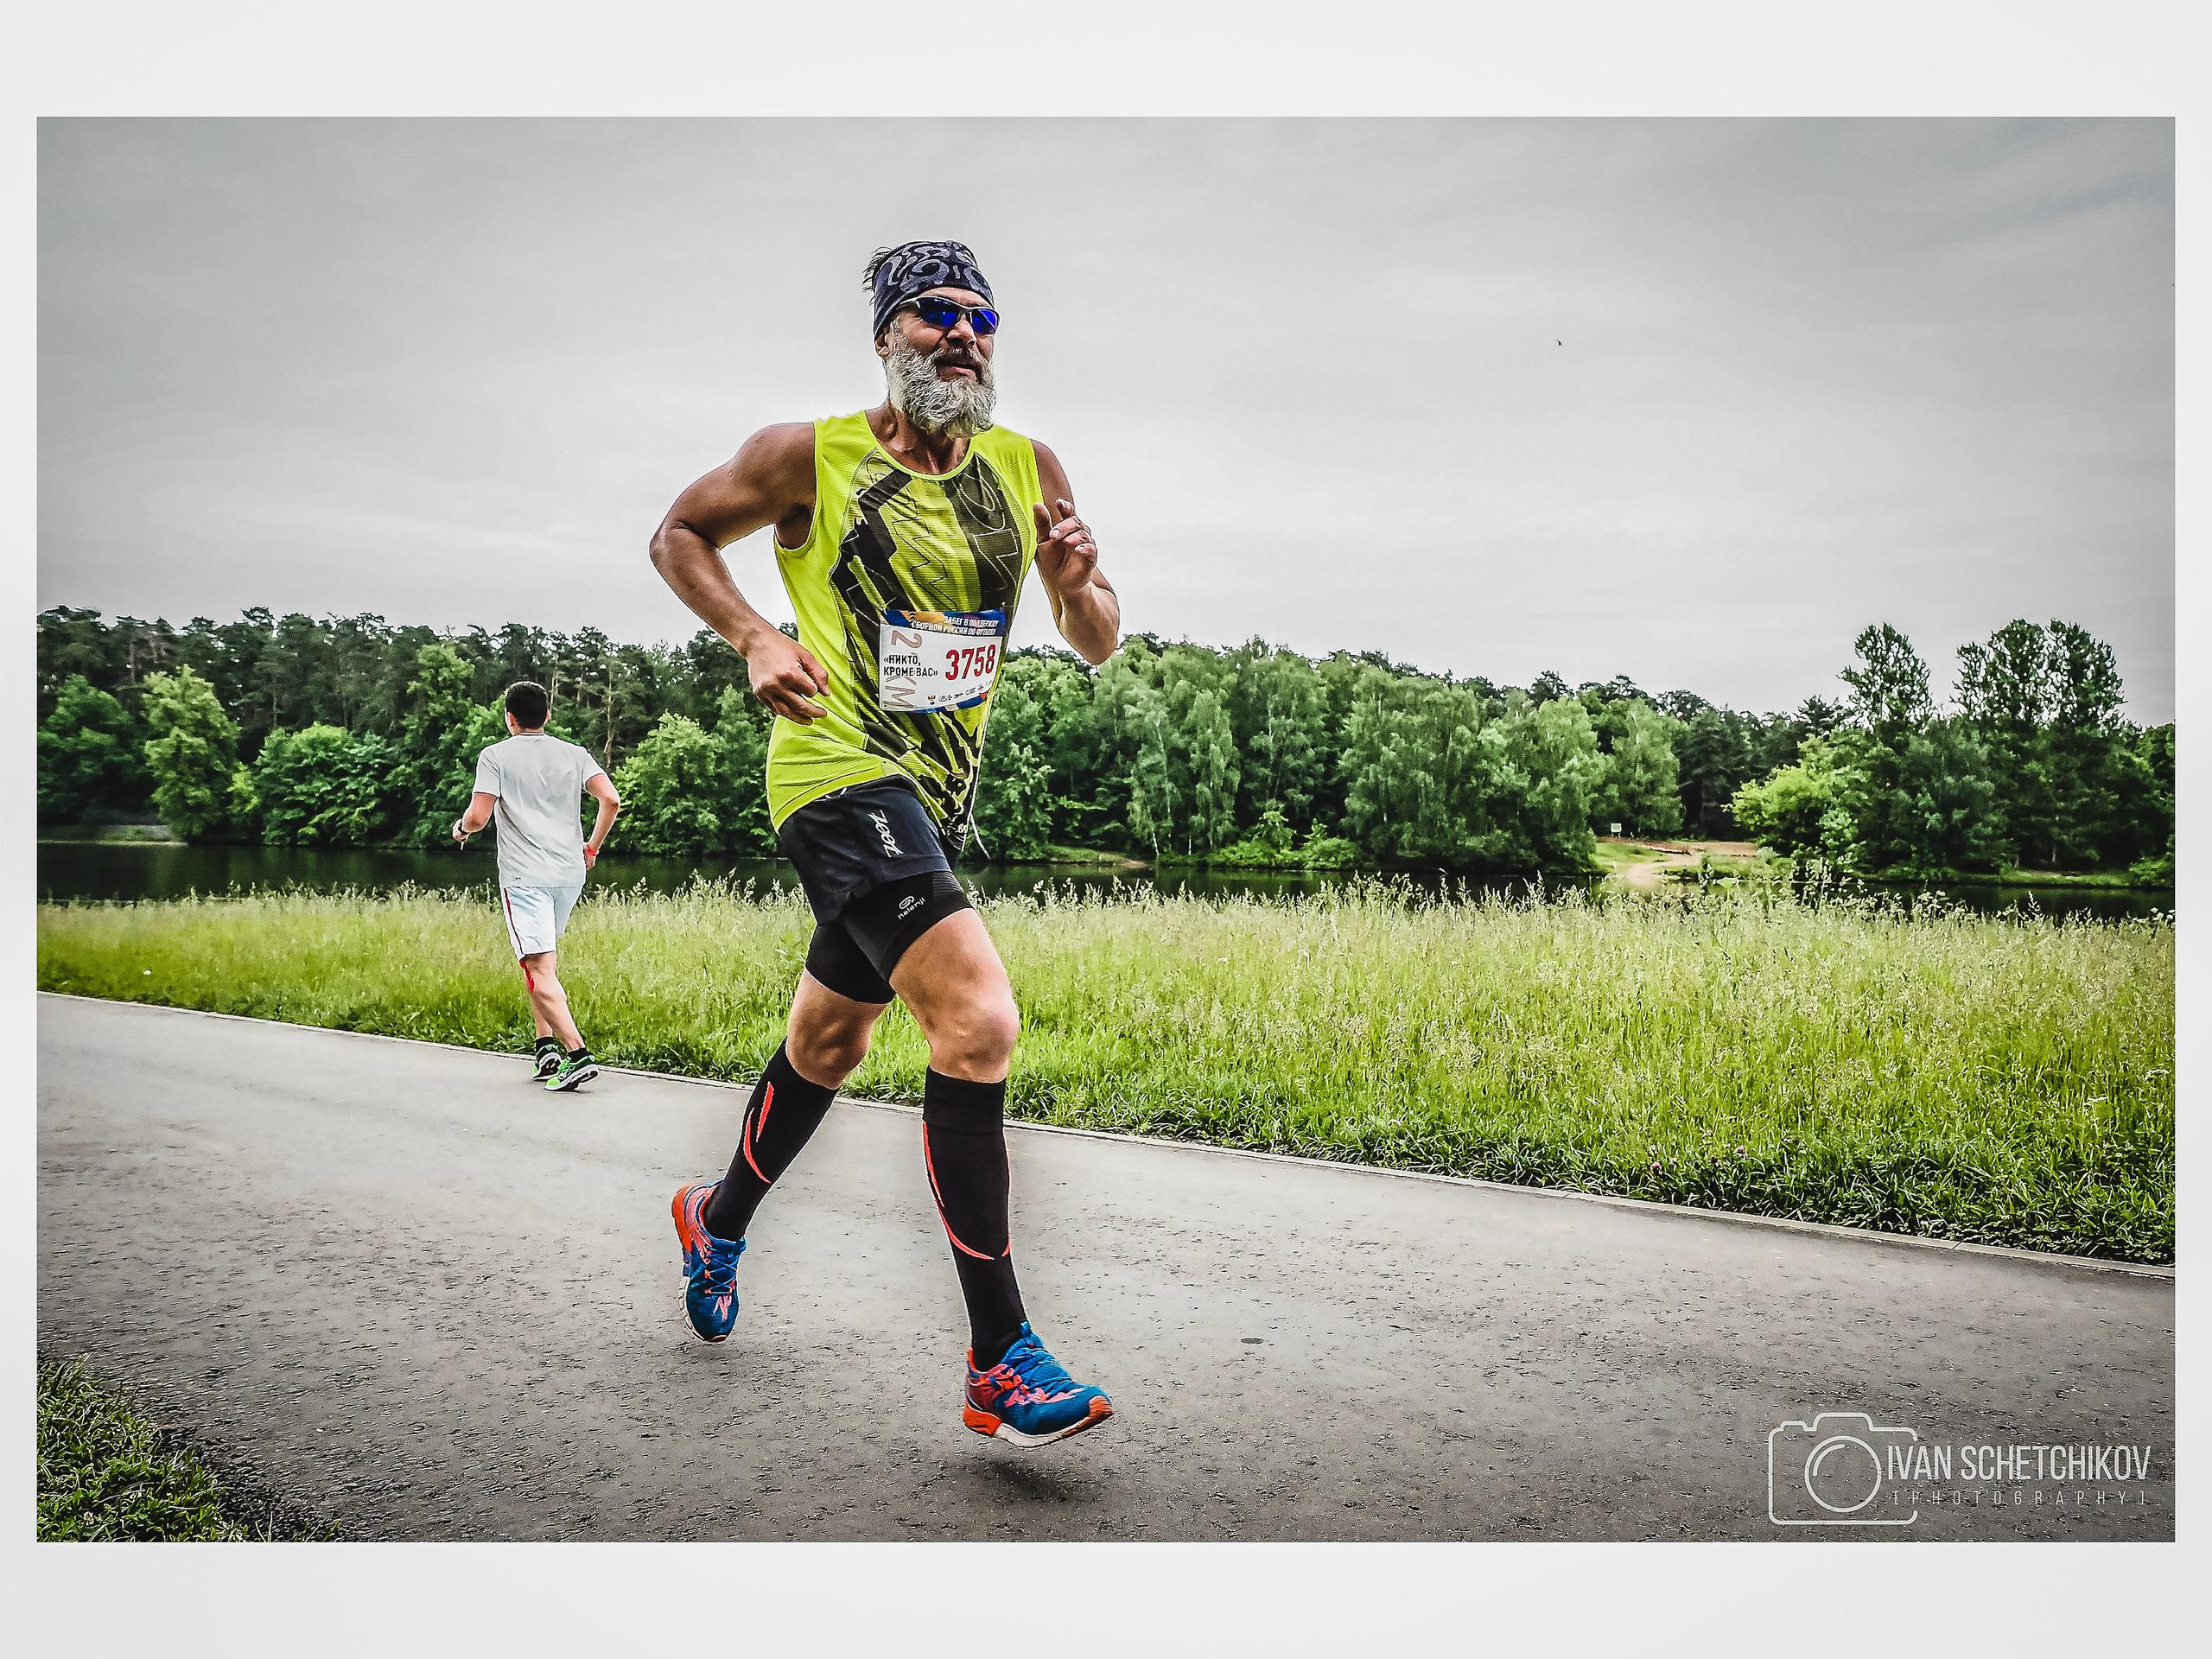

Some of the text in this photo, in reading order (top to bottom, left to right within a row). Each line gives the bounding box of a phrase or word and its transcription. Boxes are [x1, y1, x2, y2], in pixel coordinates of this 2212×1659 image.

[912, 620, 943, 632] СБОРНОЙ
[943, 625, 968, 635] РОССИИ
[944, 616, 963, 626] ЗАБЕГ
[945, 644, 996, 681] 3758
[883, 666, 914, 677] КРОМЕ
